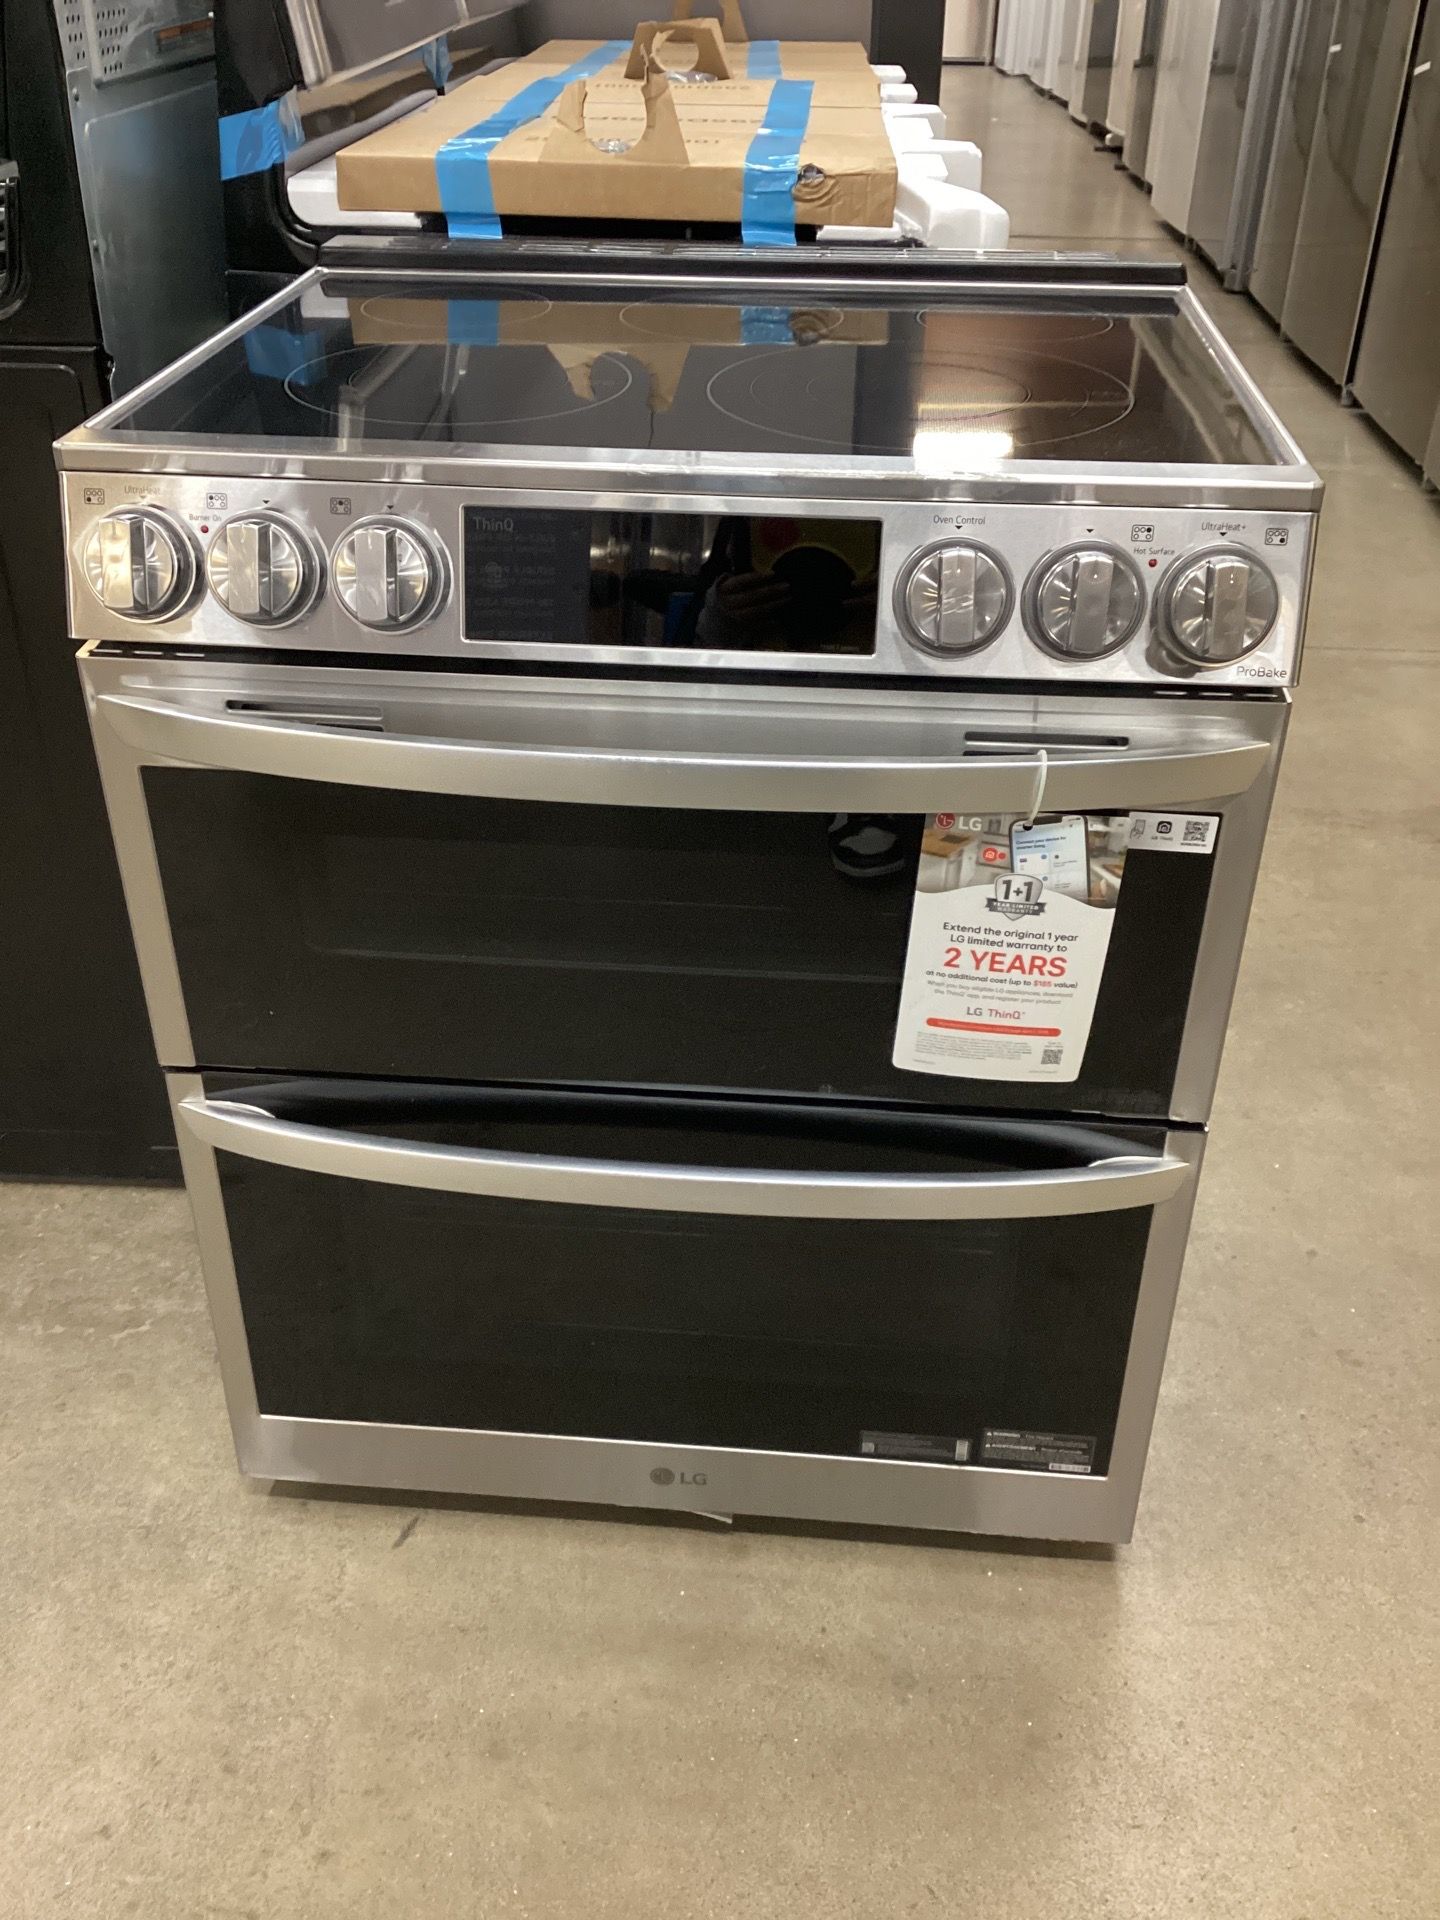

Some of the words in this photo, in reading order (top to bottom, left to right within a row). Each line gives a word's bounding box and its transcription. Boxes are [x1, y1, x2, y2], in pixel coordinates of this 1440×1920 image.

[189, 513, 210, 521] Burner
[473, 516, 514, 532] ThinQ
[933, 514, 954, 524] Oven
[955, 515, 986, 525] Control
[1133, 546, 1147, 555] Hot
[1148, 547, 1176, 556] Surface
[1236, 665, 1287, 678] ProBake
[958, 815, 982, 831] LG
[1002, 879, 1034, 902] 1+1
[943, 922, 981, 934] Extend
[984, 927, 1001, 936] the
[1004, 929, 1045, 941] original
[1054, 933, 1079, 942] year
[950, 934, 964, 943] LG
[967, 935, 1004, 947] limited
[1006, 941, 1053, 953] warranty
[1057, 944, 1068, 952] to
[943, 947, 962, 969] 2
[970, 949, 1068, 977] YEARS
[948, 972, 989, 982] additional
[990, 976, 1007, 984] cost
[966, 1006, 983, 1016] LG
[680, 1471, 708, 1486] LG
